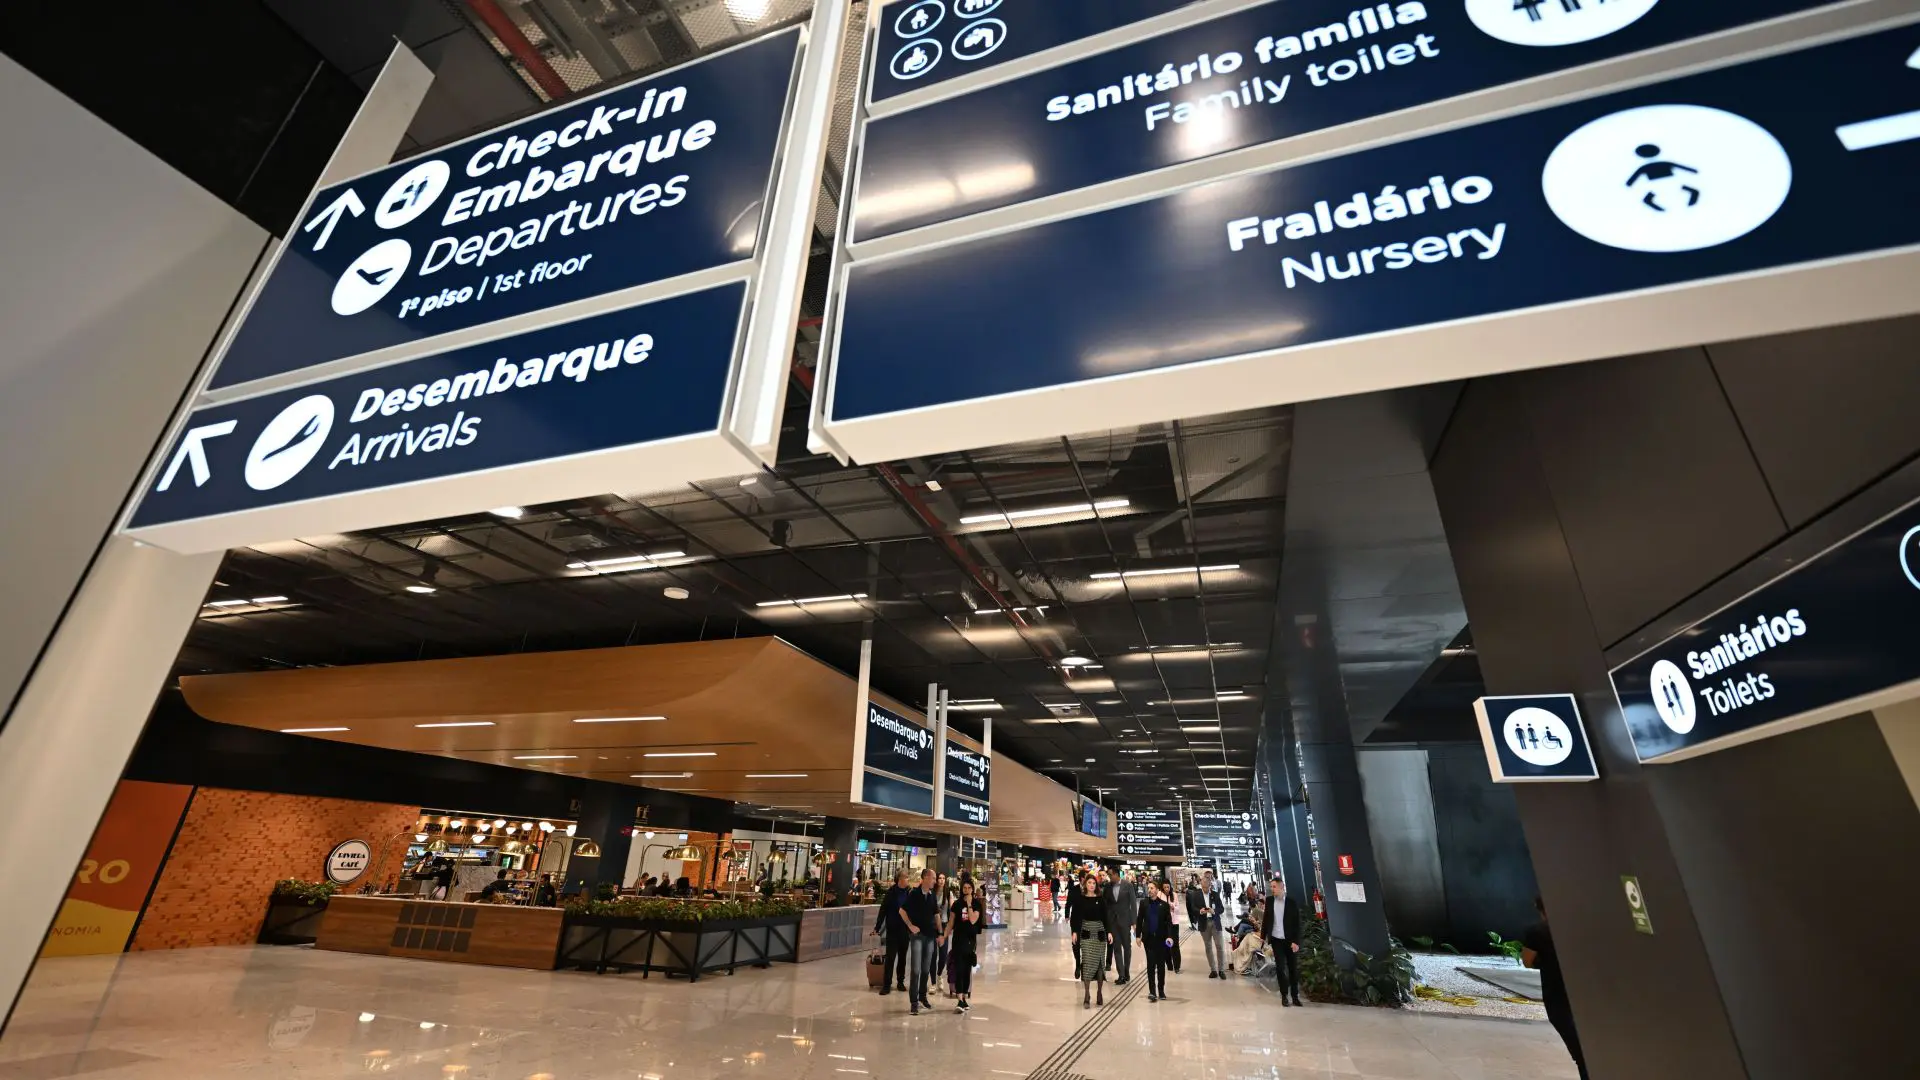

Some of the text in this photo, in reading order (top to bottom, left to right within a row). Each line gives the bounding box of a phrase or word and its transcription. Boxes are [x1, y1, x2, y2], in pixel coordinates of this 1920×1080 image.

[1046, 1, 1427, 121] Sanitário família
[1145, 33, 1440, 131] Family toilet
[465, 86, 687, 178] Check-in
[441, 119, 717, 226] Embarque
[419, 174, 690, 276] Departures
[1227, 175, 1493, 251] Fraldário
[418, 286, 474, 317] piso
[493, 269, 525, 293] 1st
[529, 253, 592, 284] floor
[1281, 222, 1507, 289] Nursery
[349, 333, 654, 423] Desembarque
[328, 411, 482, 470] Arrivals
[1686, 608, 1807, 679] Sanitários
[870, 708, 919, 742] Desembarque
[1700, 672, 1775, 716] Toilets
[893, 738, 918, 760] Arrivals
